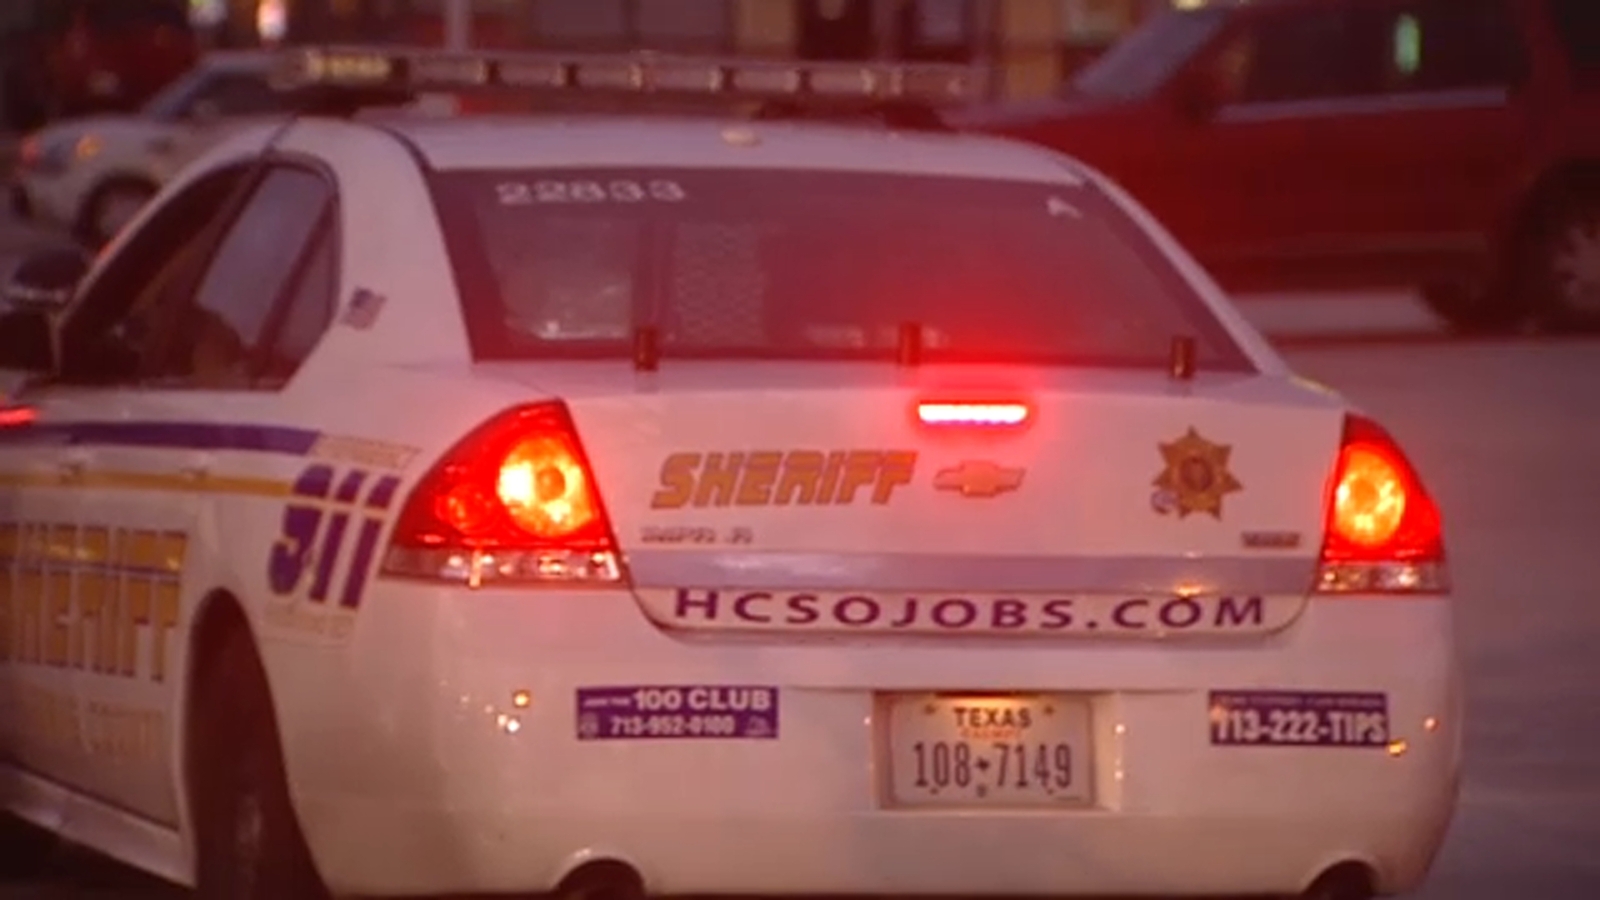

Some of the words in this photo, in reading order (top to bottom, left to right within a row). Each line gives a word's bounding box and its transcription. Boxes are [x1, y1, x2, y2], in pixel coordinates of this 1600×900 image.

[650, 448, 917, 509] SHERIFF
[266, 463, 401, 609] 911
[674, 587, 1266, 630] HCSOJOBS.COM
[633, 688, 682, 711] 100
[687, 688, 772, 711] CLUB
[953, 706, 1033, 729] TEXAS
